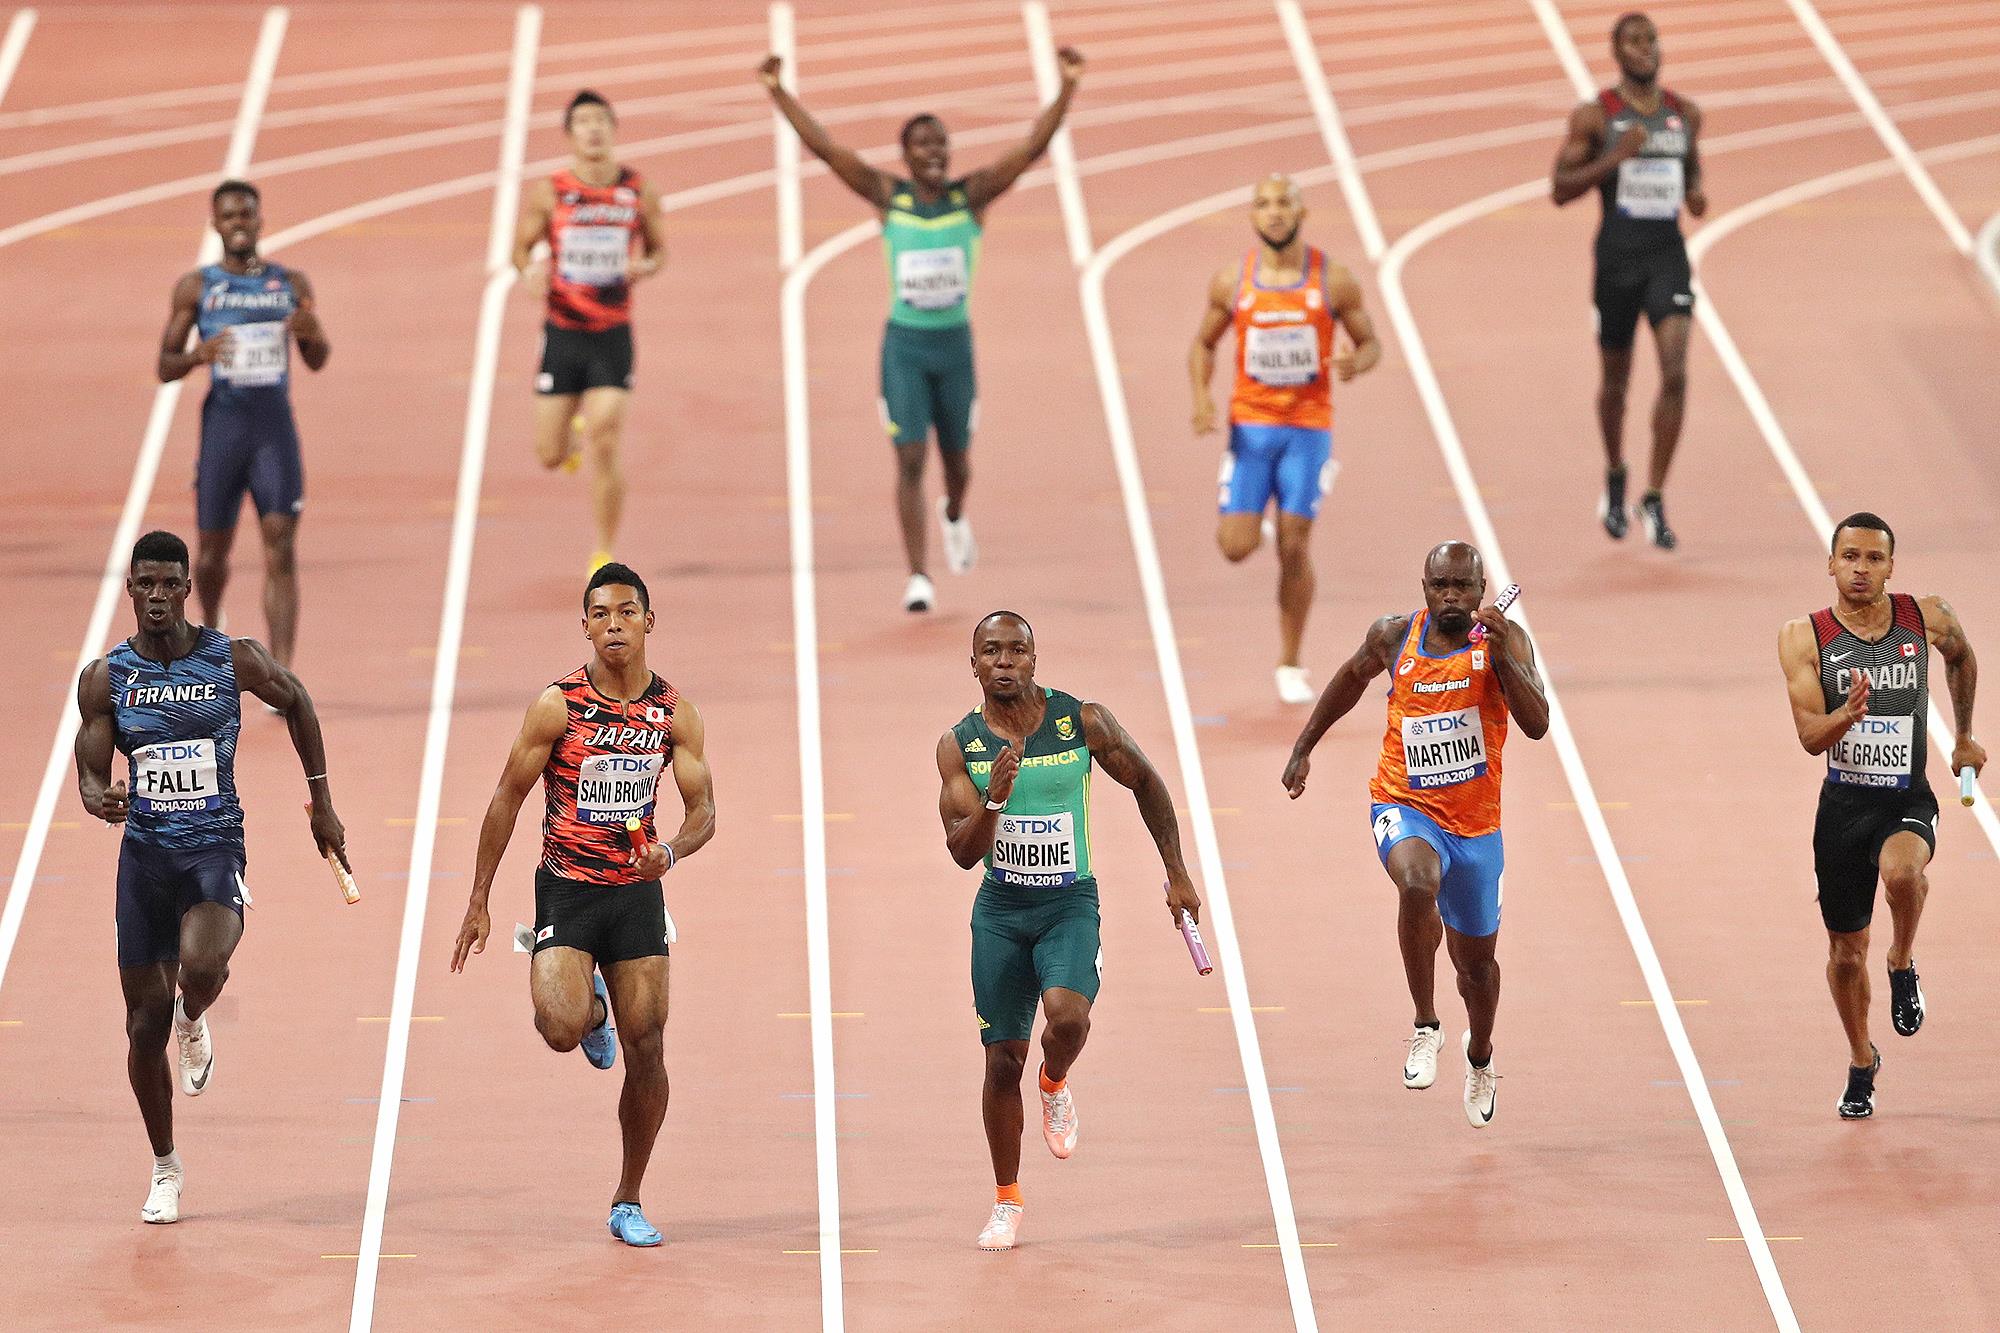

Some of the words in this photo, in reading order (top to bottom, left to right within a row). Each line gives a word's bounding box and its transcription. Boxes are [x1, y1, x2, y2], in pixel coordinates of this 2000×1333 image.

[1412, 676, 1470, 693] Nederland
[135, 684, 217, 705] FRANCE
[1422, 712, 1468, 734] TDK
[1861, 721, 1900, 734] TDK
[583, 726, 665, 749] JAPAN
[157, 743, 202, 760] TDK
[1020, 750, 1080, 768] AFRICA
[1407, 735, 1481, 768] MARTINA
[1853, 743, 1907, 767] GRASSE
[609, 758, 653, 772] TDK
[146, 769, 204, 794] FALL
[1420, 767, 1475, 787] DOHA2019
[1840, 771, 1899, 786] DOHA2019
[581, 780, 611, 803] SANI
[150, 799, 206, 811] DOHA2019
[1016, 818, 1062, 833] TDK
[995, 839, 1070, 867] SIMBINE
[1004, 872, 1063, 886] DOHA2019
